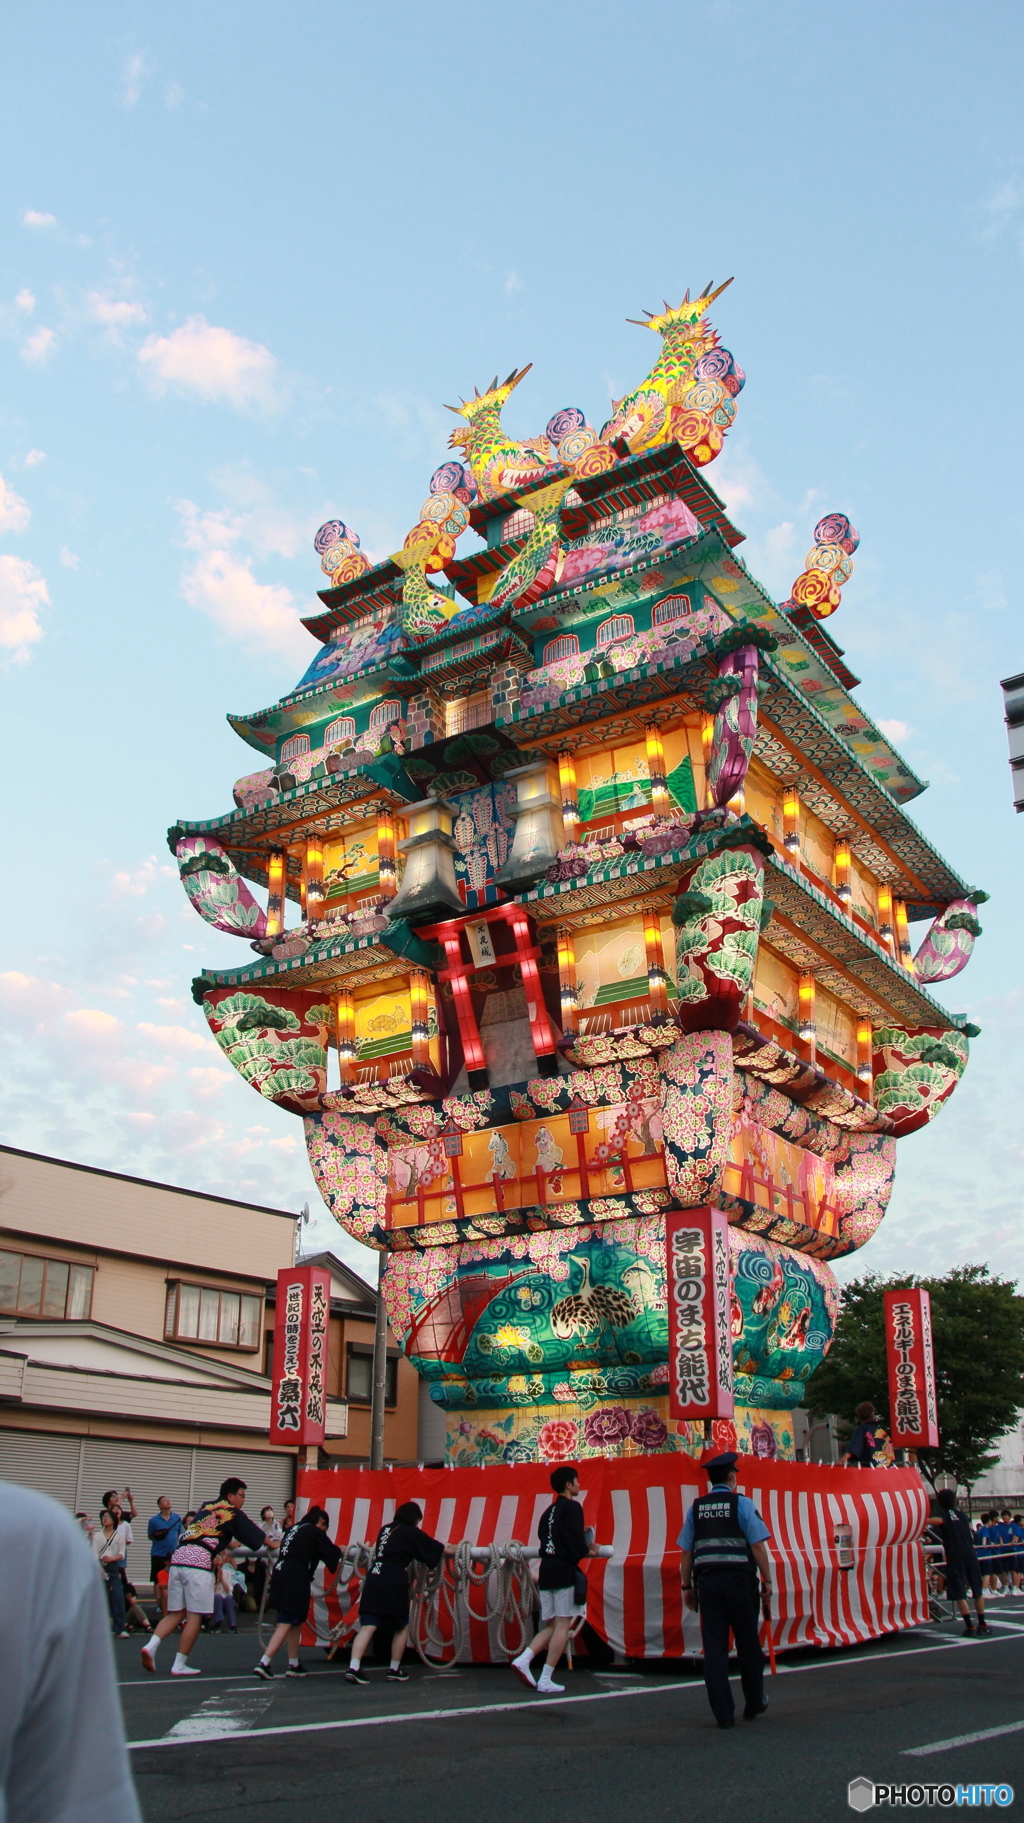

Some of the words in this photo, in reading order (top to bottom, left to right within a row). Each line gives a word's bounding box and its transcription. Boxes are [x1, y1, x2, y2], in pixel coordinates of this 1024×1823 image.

[477, 925, 492, 957] 不夜城
[307, 1284, 326, 1424] 天空の不夜城
[673, 1230, 708, 1405] 宇宙のまち能代
[714, 1228, 732, 1394] 天空の不夜城
[893, 1303, 921, 1433] エネルギーのまち能代
[699, 1511, 730, 1519] POLICE
